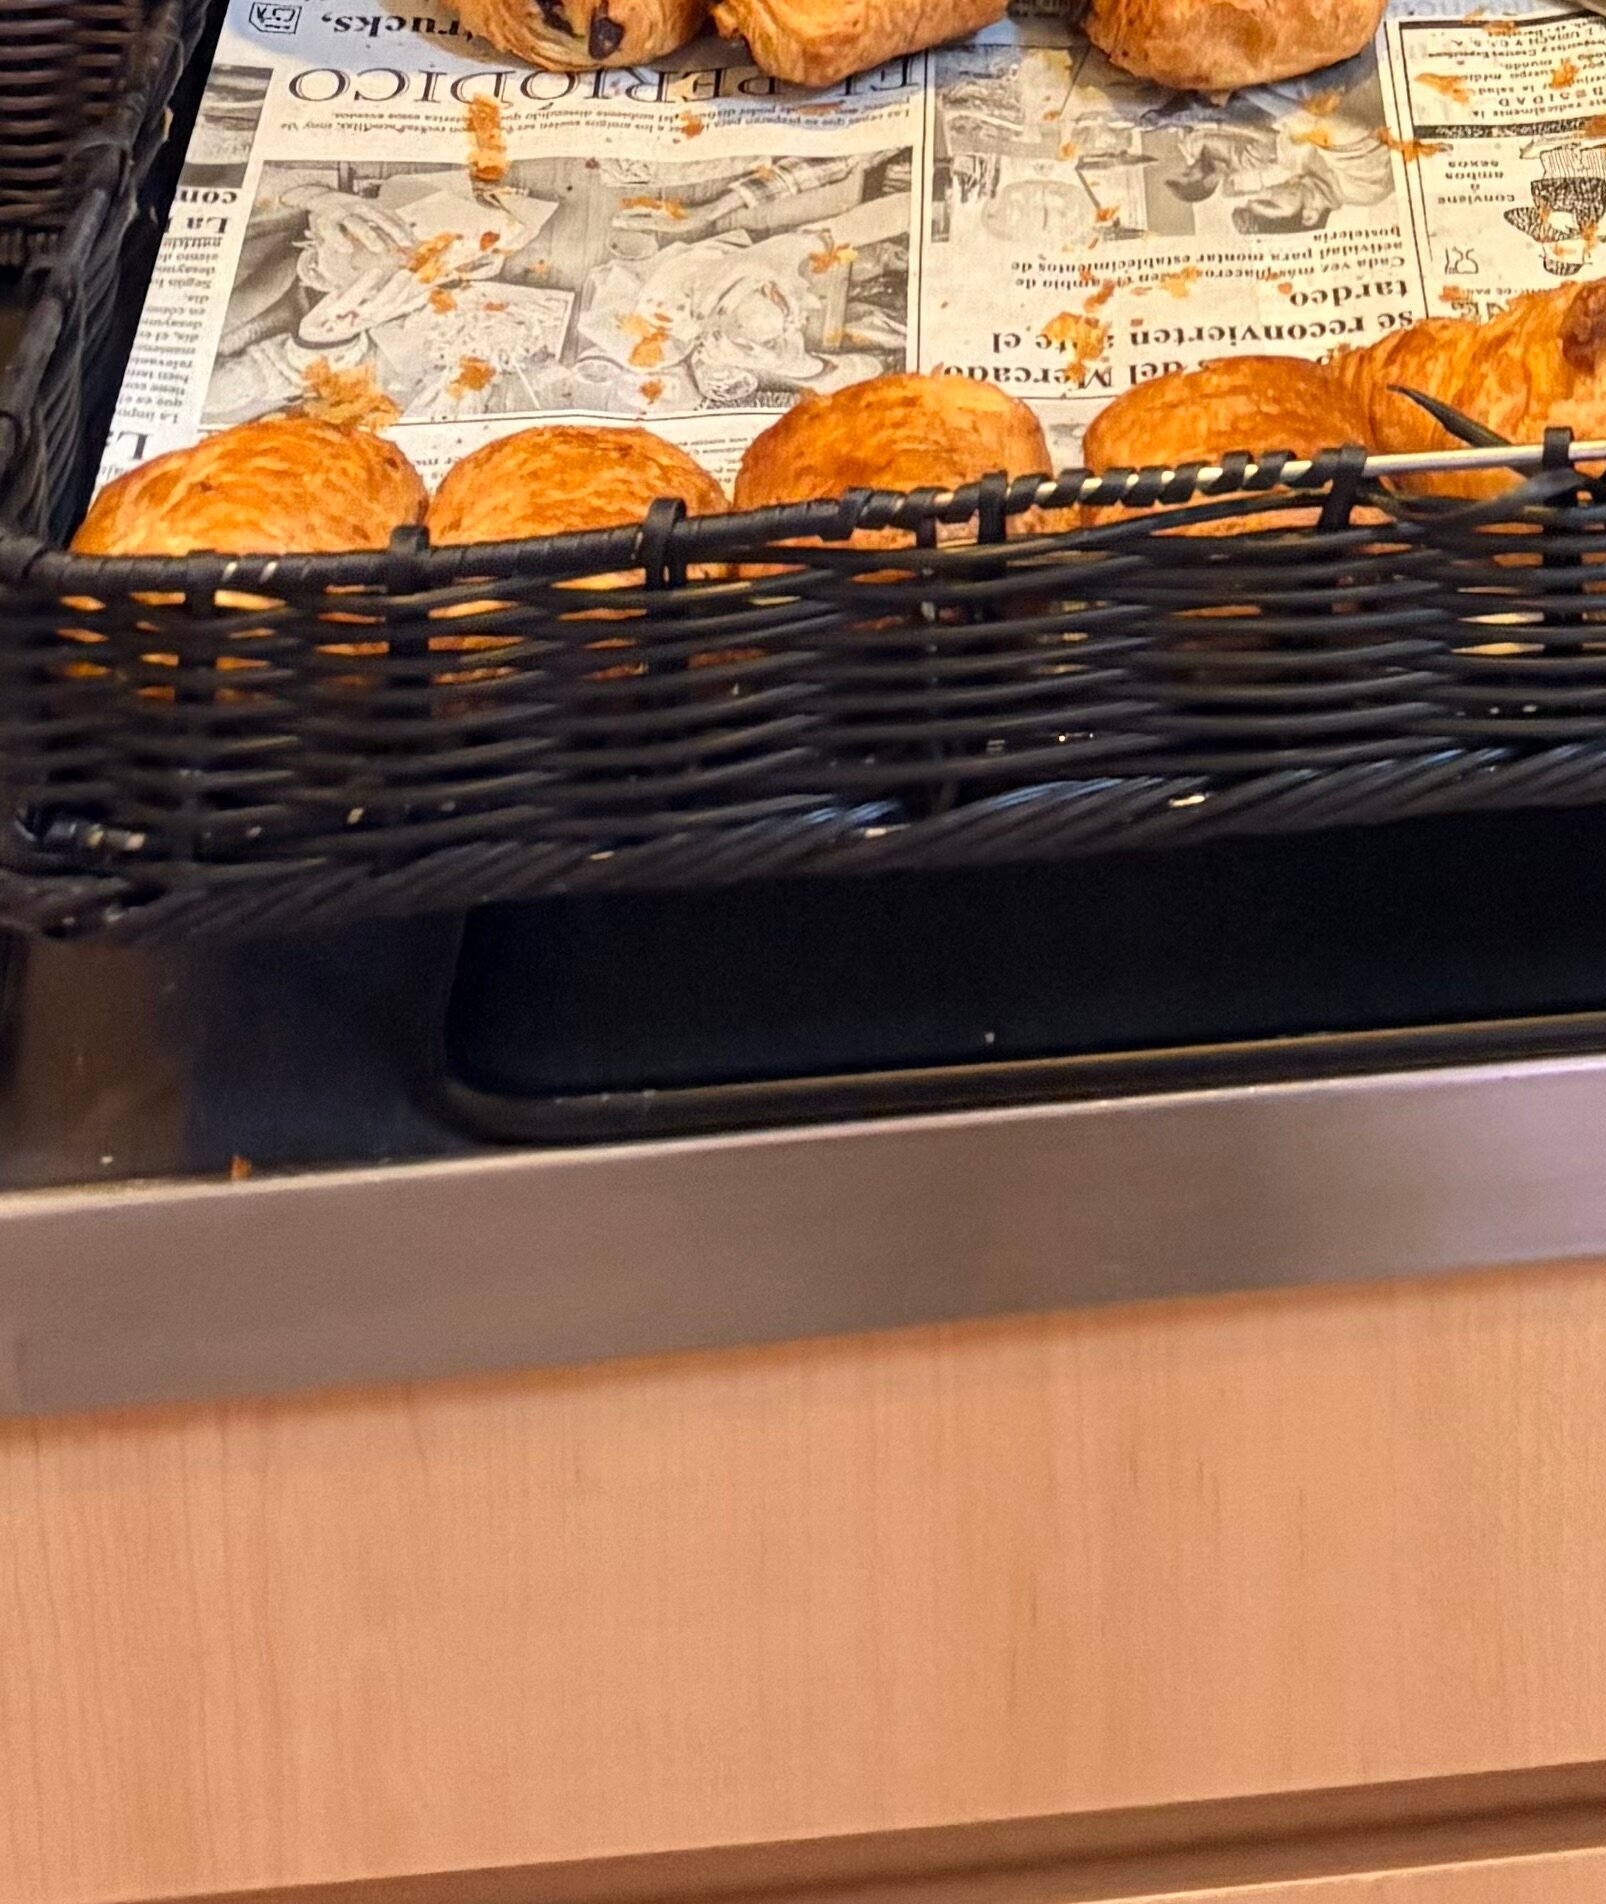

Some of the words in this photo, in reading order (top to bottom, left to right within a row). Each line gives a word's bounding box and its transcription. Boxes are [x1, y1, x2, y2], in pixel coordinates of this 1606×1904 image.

[289, 65, 785, 109] PERIÓDICO
[1448, 160, 1499, 168] sexos
[1445, 171, 1503, 179] ambos
[1437, 195, 1515, 205] conviene
[186, 217, 229, 234] La
[1198, 252, 1265, 267] montar
[1271, 248, 1313, 264] para
[1320, 241, 1404, 261] actividad
[1010, 261, 1032, 275] de
[1037, 253, 1192, 275] establecimientos
[1319, 259, 1351, 273] vez
[1356, 255, 1406, 271] Cada
[1014, 277, 1037, 291] de
[1289, 278, 1408, 311] tardeo
[1377, 308, 1414, 331] se
[1129, 315, 1365, 349] reconvierten
[991, 331, 1021, 355] el
[941, 361, 1112, 390] Mercado
[1128, 359, 1183, 385] del
